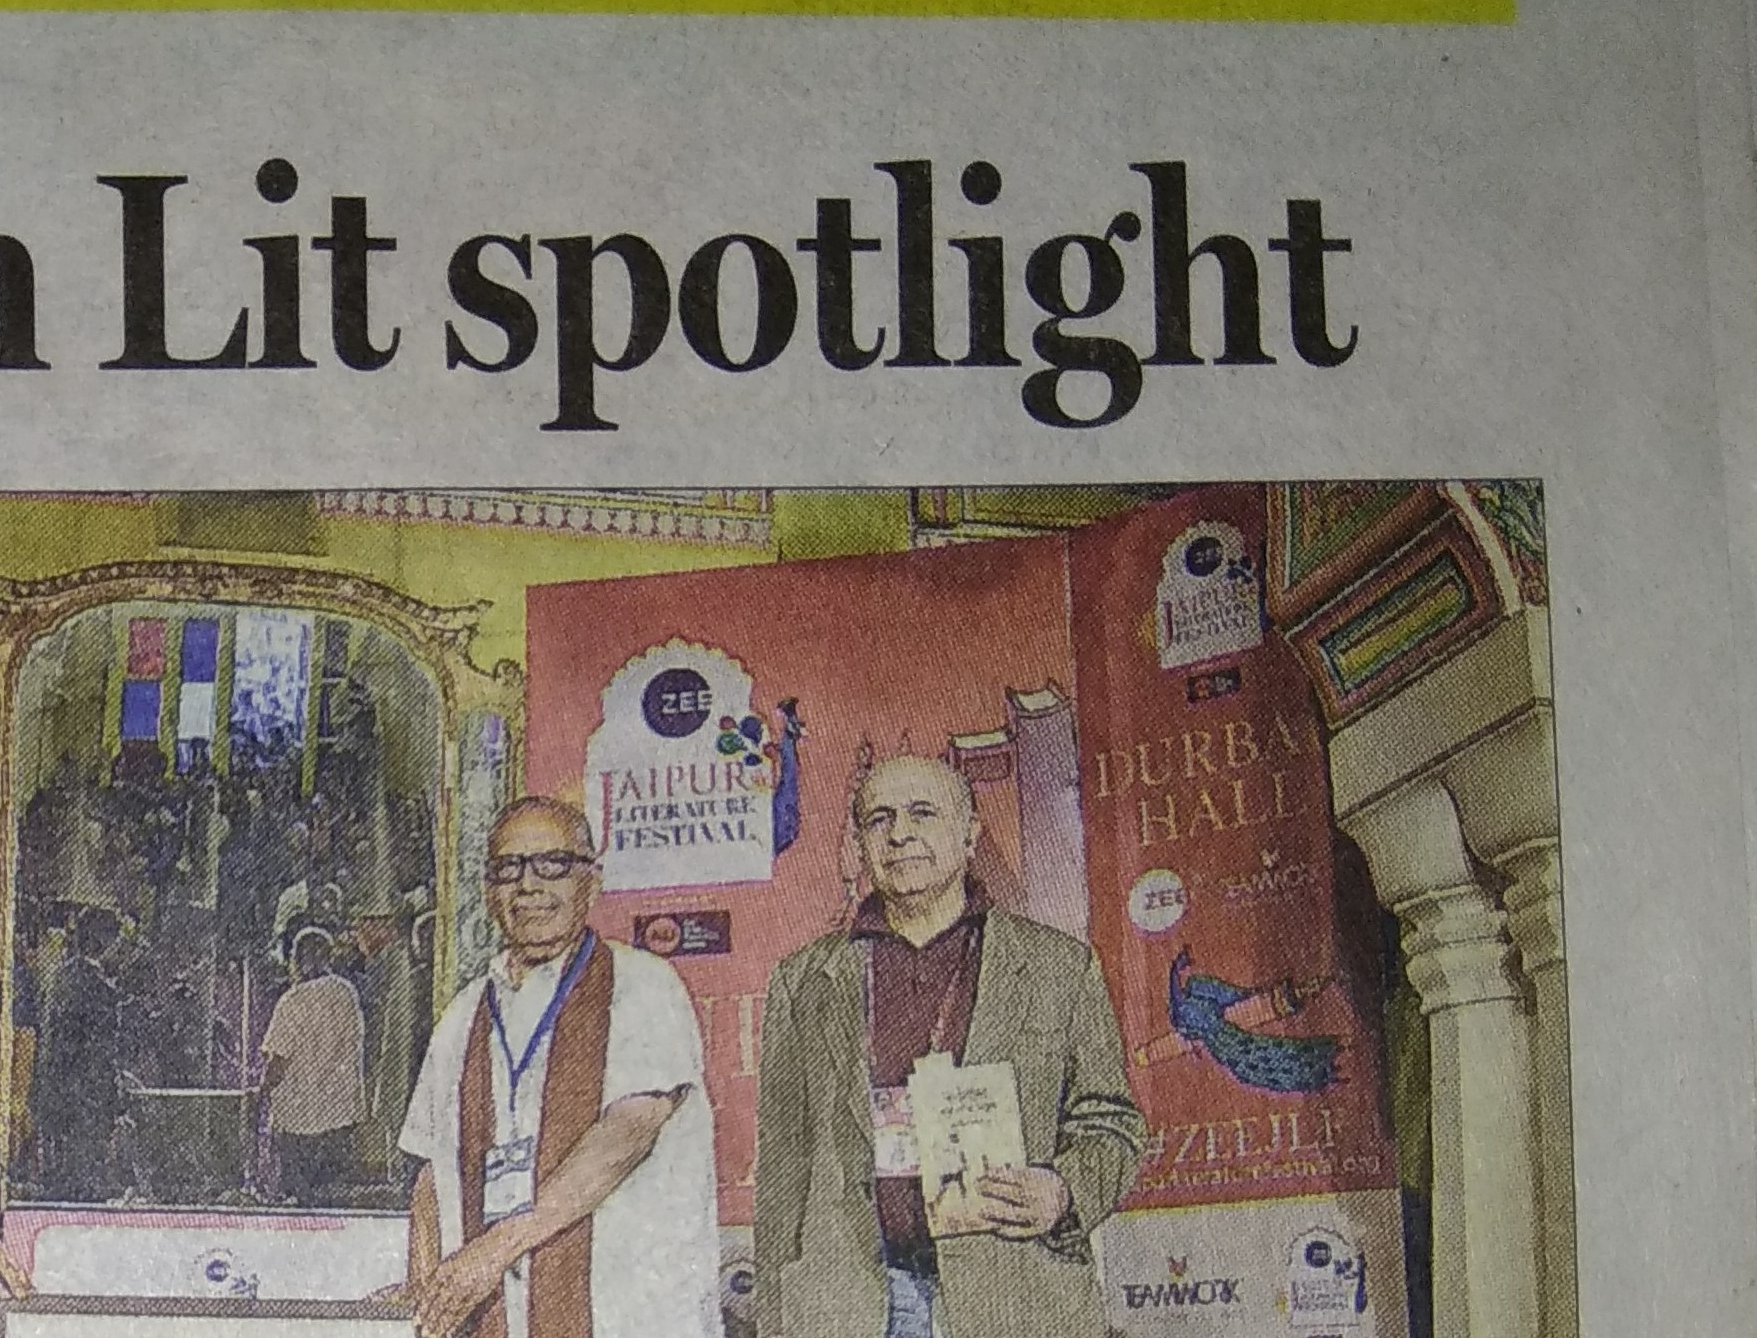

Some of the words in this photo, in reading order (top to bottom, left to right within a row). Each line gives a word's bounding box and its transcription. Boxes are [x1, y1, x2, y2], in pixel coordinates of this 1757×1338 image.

[95, 157, 402, 372] Lit
[444, 158, 1359, 432] spotlight
[661, 689, 713, 715] ZEE
[614, 795, 757, 824] LITERATURE
[614, 819, 757, 851] FESTIVAL
[1122, 1278, 1243, 1309] TEAMWORK
